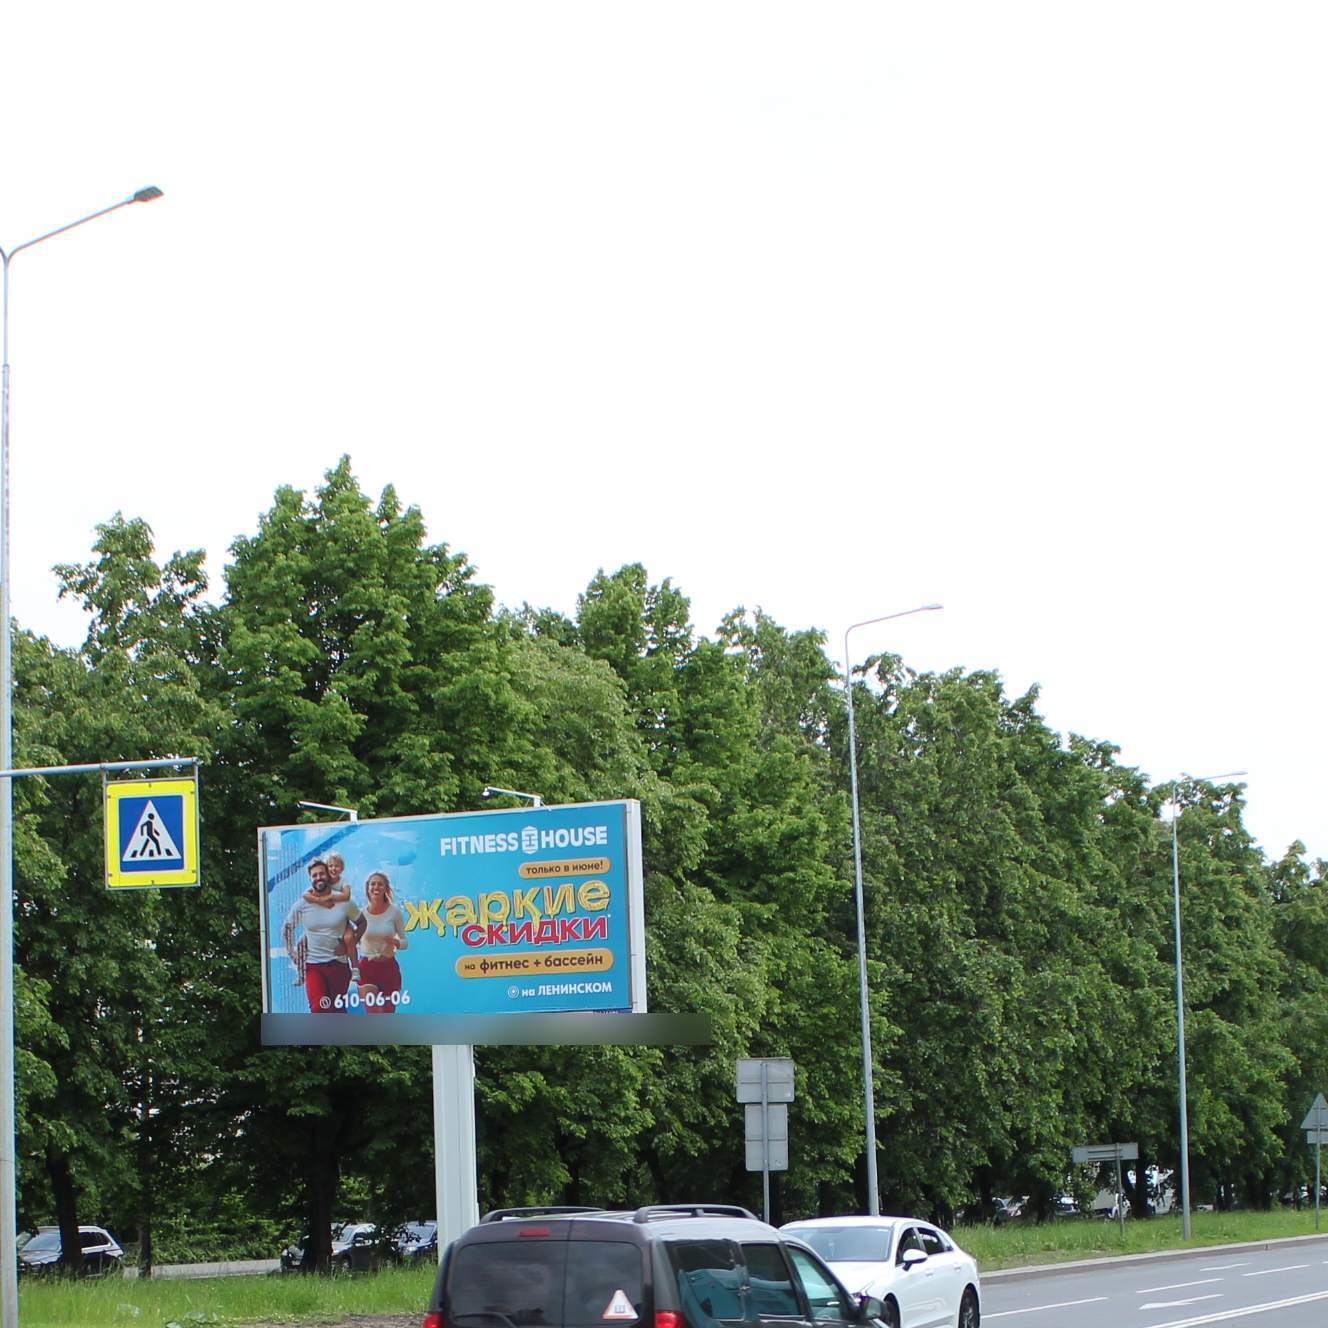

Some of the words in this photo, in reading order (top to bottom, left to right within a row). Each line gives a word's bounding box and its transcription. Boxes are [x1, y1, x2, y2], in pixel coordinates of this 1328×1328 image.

[440, 832, 519, 857] FITNESS
[541, 826, 608, 849] HOUSE
[526, 866, 561, 875] только
[564, 865, 570, 873] в
[572, 861, 604, 871] июне!
[464, 963, 476, 971] на
[479, 959, 529, 973] фитнес
[544, 953, 603, 968] бассейн
[521, 989, 535, 997] на
[537, 982, 612, 997] ЛЕНИНСКОМ
[334, 990, 411, 1009] 610-06-06
